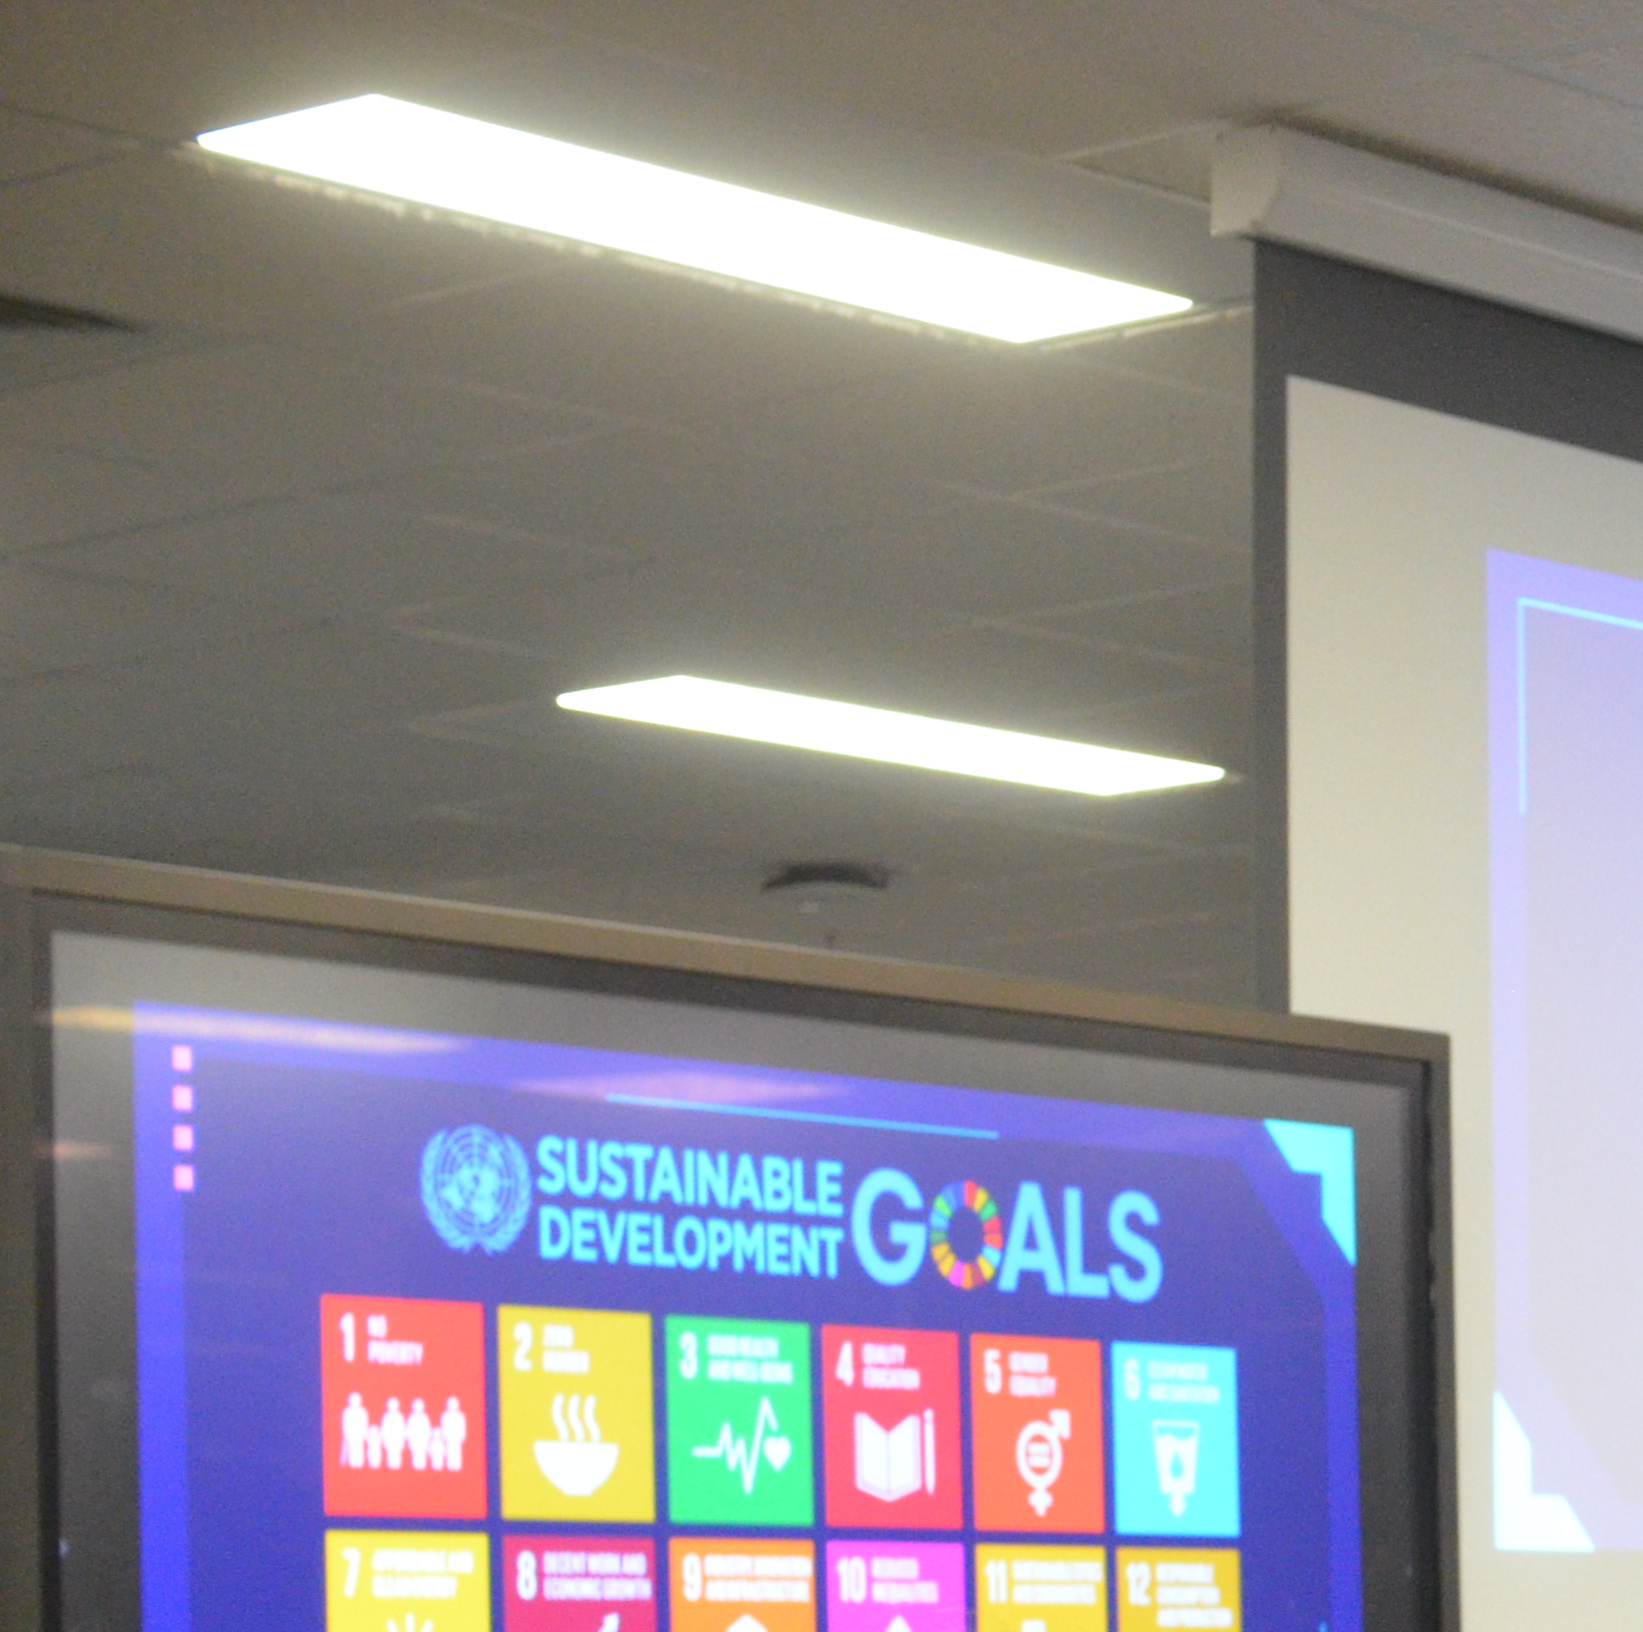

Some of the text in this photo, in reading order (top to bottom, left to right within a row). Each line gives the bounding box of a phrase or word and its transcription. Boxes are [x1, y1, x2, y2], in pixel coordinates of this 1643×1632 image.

[536, 1135, 845, 1218] SUSTAINABLE
[537, 1204, 845, 1280] DEVELOPMENT
[850, 1166, 1164, 1303] GOALS
[339, 1311, 356, 1364] 1
[513, 1321, 534, 1372] 2
[679, 1330, 699, 1381] 3
[834, 1340, 855, 1388] 4
[983, 1348, 1003, 1395] 5
[1123, 1357, 1141, 1402] 6
[342, 1547, 361, 1599] 7
[515, 1549, 539, 1601] 8
[681, 1552, 703, 1603] 9
[836, 1555, 868, 1604] 10
[983, 1559, 1009, 1605] 11
[1125, 1560, 1152, 1607] 12
